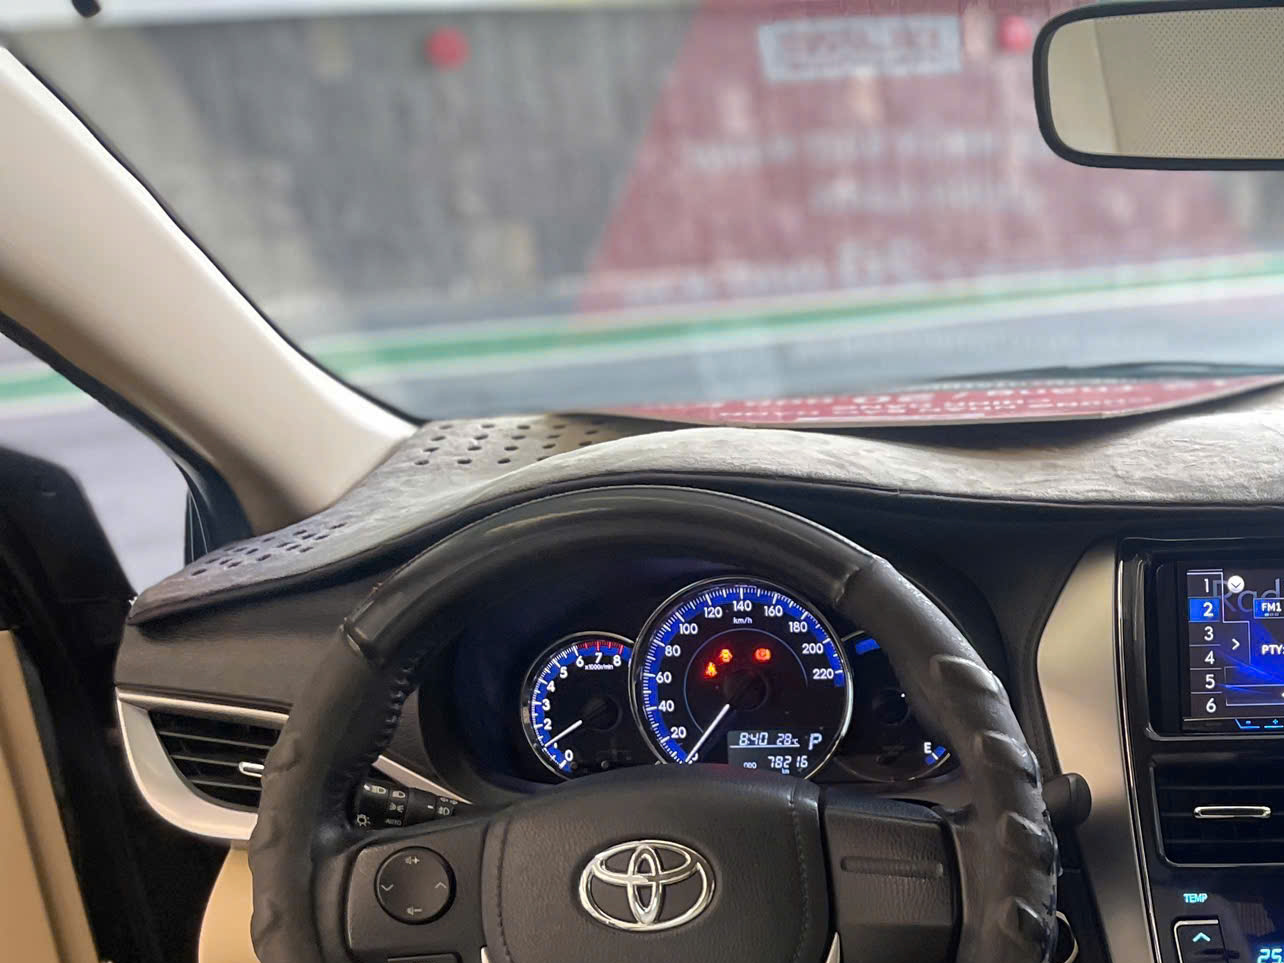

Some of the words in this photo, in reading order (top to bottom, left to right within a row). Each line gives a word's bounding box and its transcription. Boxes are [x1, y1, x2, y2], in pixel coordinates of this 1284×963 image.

[1203, 578, 1210, 593] 1
[704, 606, 723, 619] 120
[733, 600, 752, 612] 140
[764, 605, 783, 617] 160
[1203, 602, 1214, 617] 2
[1261, 602, 1282, 612] FM1
[733, 616, 753, 625] km/h
[788, 621, 808, 633] 180
[679, 623, 698, 635] 100
[1204, 626, 1214, 641] 3
[664, 644, 681, 657] 80
[802, 642, 824, 655] 200
[575, 656, 585, 668] 6
[594, 652, 603, 663] 7
[612, 655, 622, 667] 8
[1204, 650, 1215, 664] 4
[559, 667, 568, 679] 5
[655, 671, 672, 684] 60
[812, 668, 834, 680] 220
[546, 680, 556, 692] 4
[1205, 674, 1215, 689] 5
[541, 698, 550, 711] 3
[658, 700, 675, 713] 40
[1206, 697, 1217, 713] 6
[543, 718, 552, 731] 2
[670, 726, 687, 739] 20
[739, 732, 769, 746] 8:40
[808, 733, 823, 751] P
[923, 741, 932, 754] E
[564, 749, 574, 762] 0
[768, 755, 809, 769] 78216
[1183, 893, 1208, 903] TEMP
